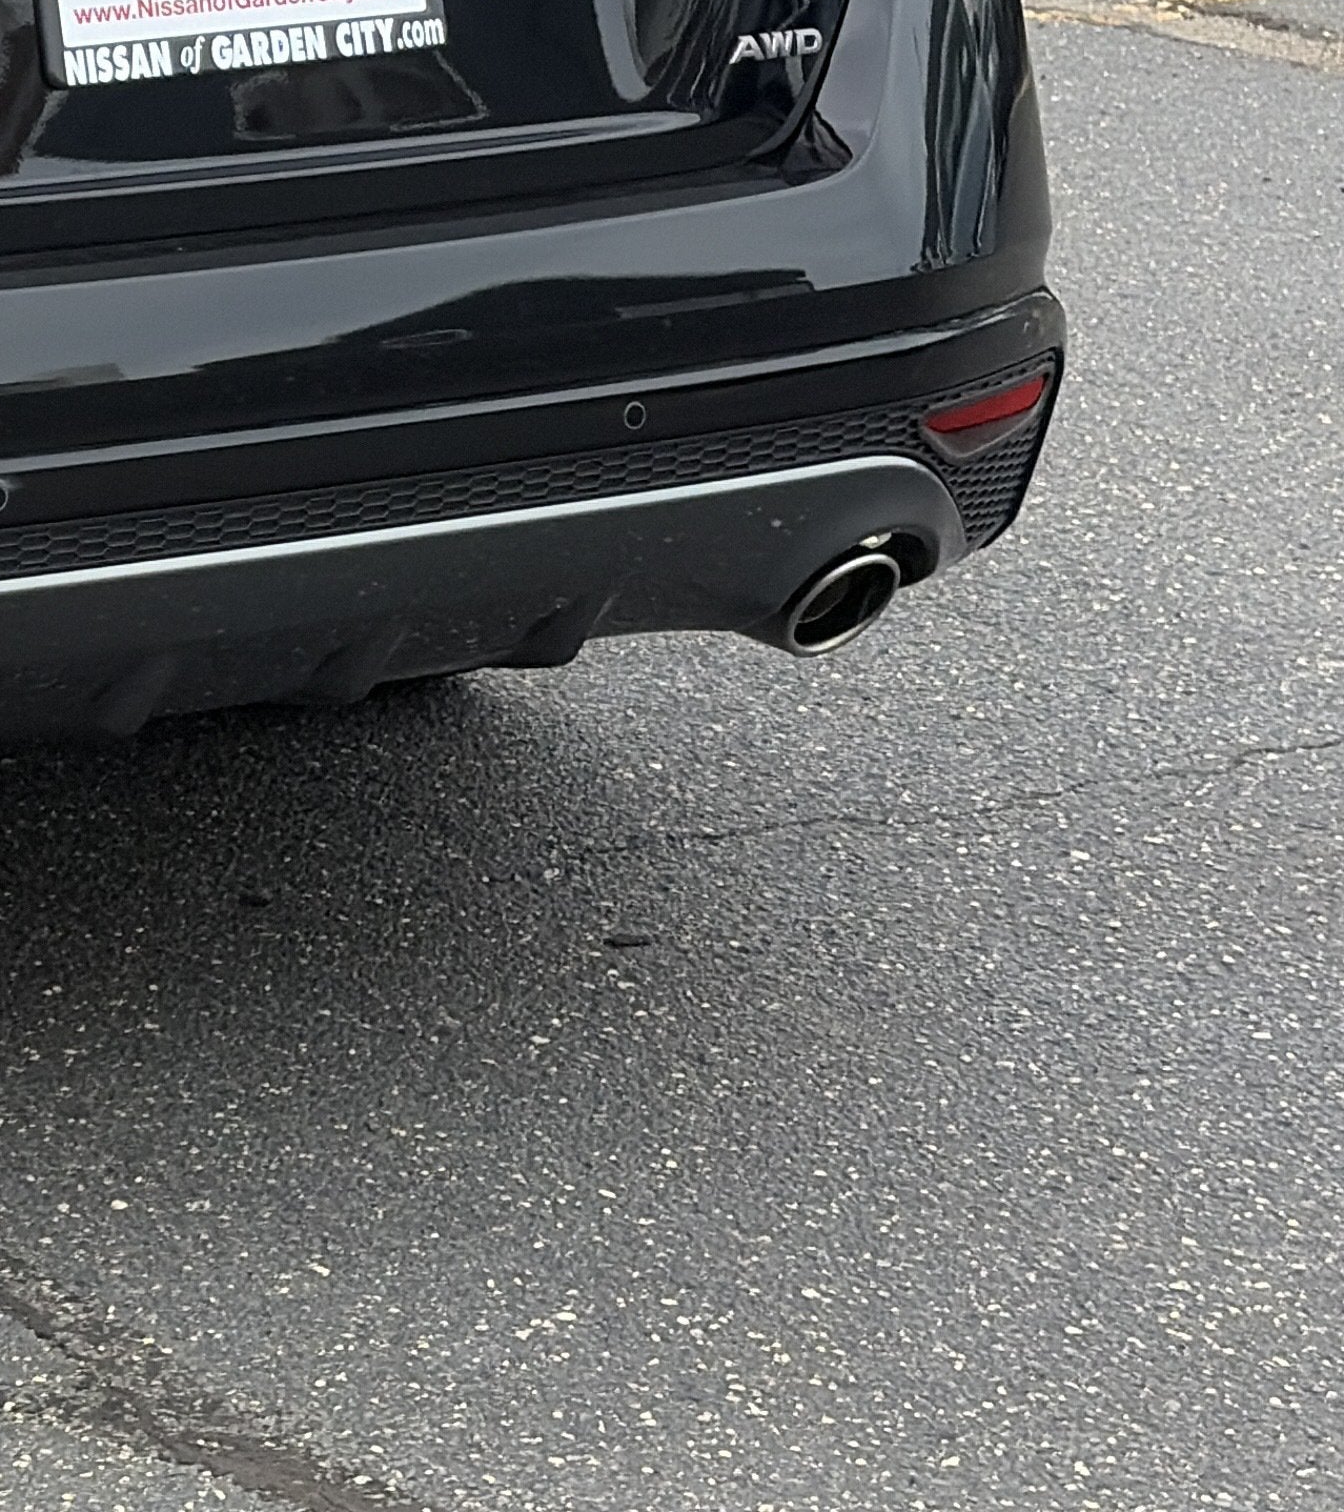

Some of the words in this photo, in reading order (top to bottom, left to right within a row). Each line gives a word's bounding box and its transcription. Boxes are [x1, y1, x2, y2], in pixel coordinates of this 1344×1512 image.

[63, 41, 172, 87] NISSAN
[180, 39, 205, 75] of
[211, 24, 327, 71] GARDEN
[335, 17, 447, 58] CITY.com
[728, 28, 823, 65] AWD
